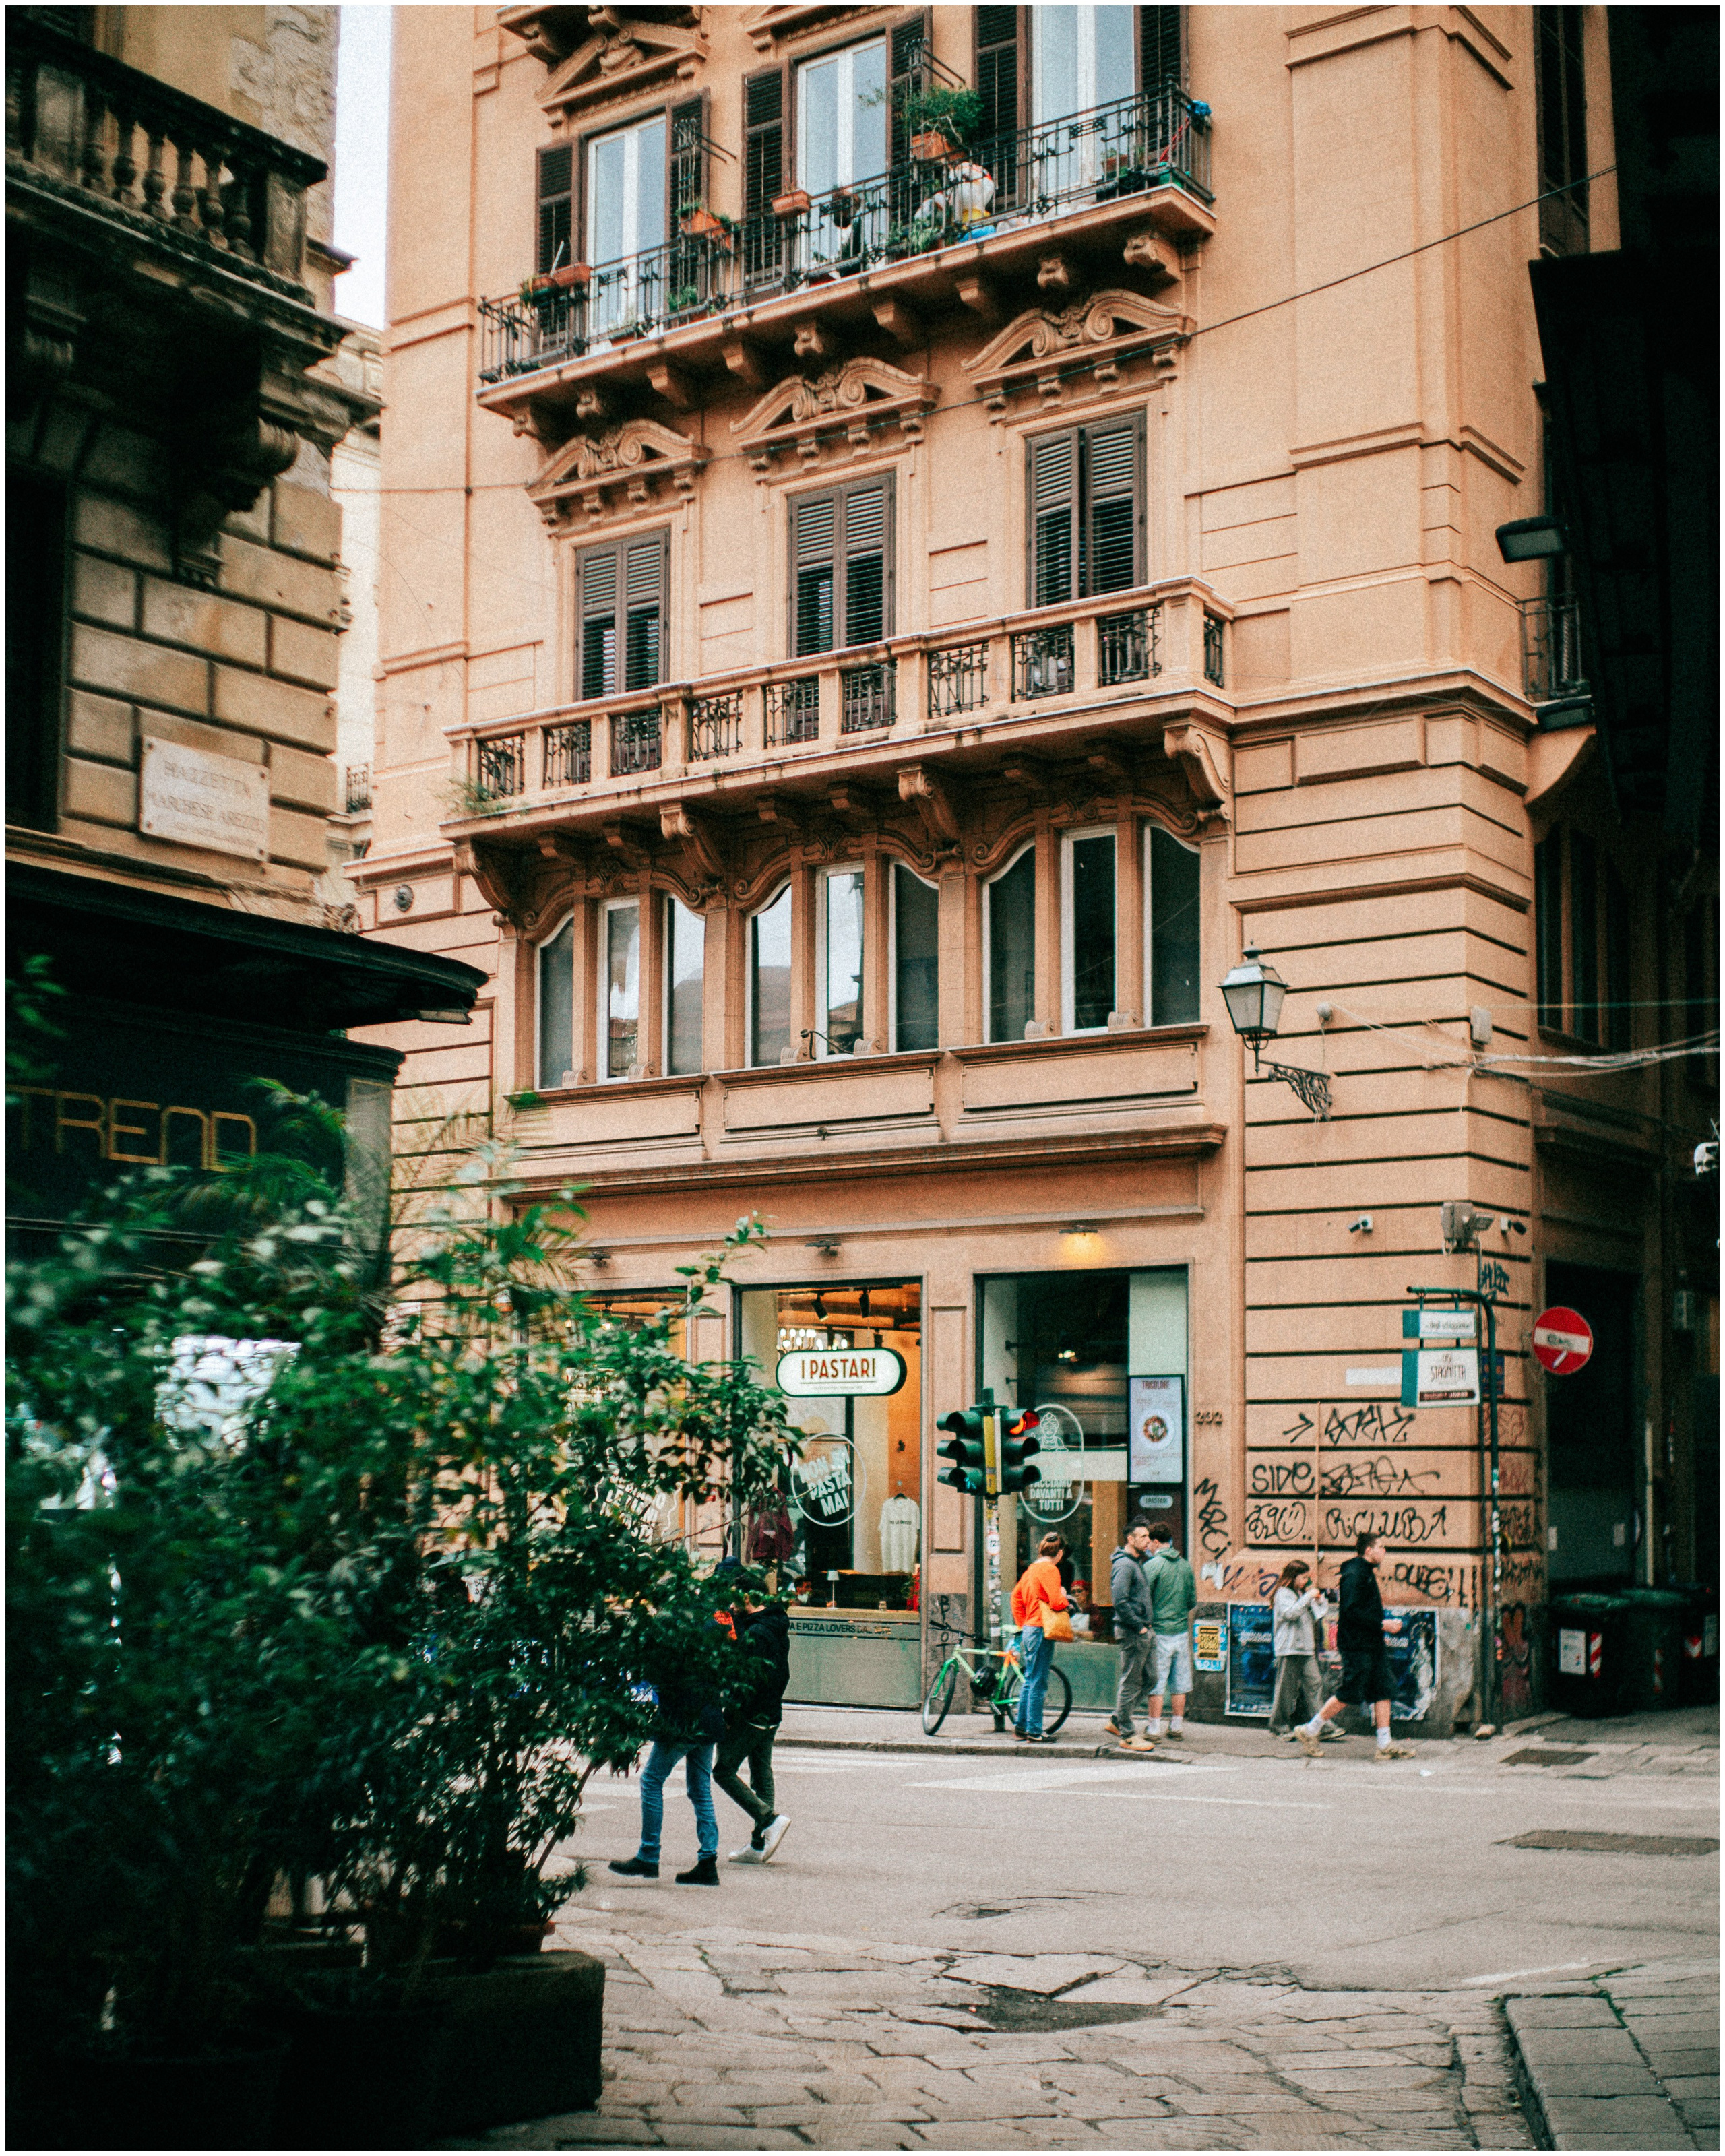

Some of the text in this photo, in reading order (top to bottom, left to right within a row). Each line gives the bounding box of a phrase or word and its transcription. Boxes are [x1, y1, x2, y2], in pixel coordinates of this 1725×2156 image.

[801, 1358, 875, 1378] I PASTARI
[1195, 1409, 1223, 1425] 232
[808, 1469, 852, 1500] PASTA
[1030, 1488, 1073, 1499] DAVANTI A
[820, 1490, 849, 1517] MAI
[1039, 1500, 1064, 1511] TUTTI
[796, 1623, 802, 1631] E
[802, 1623, 825, 1632] PIZZA
[826, 1624, 856, 1633] LOVERS
